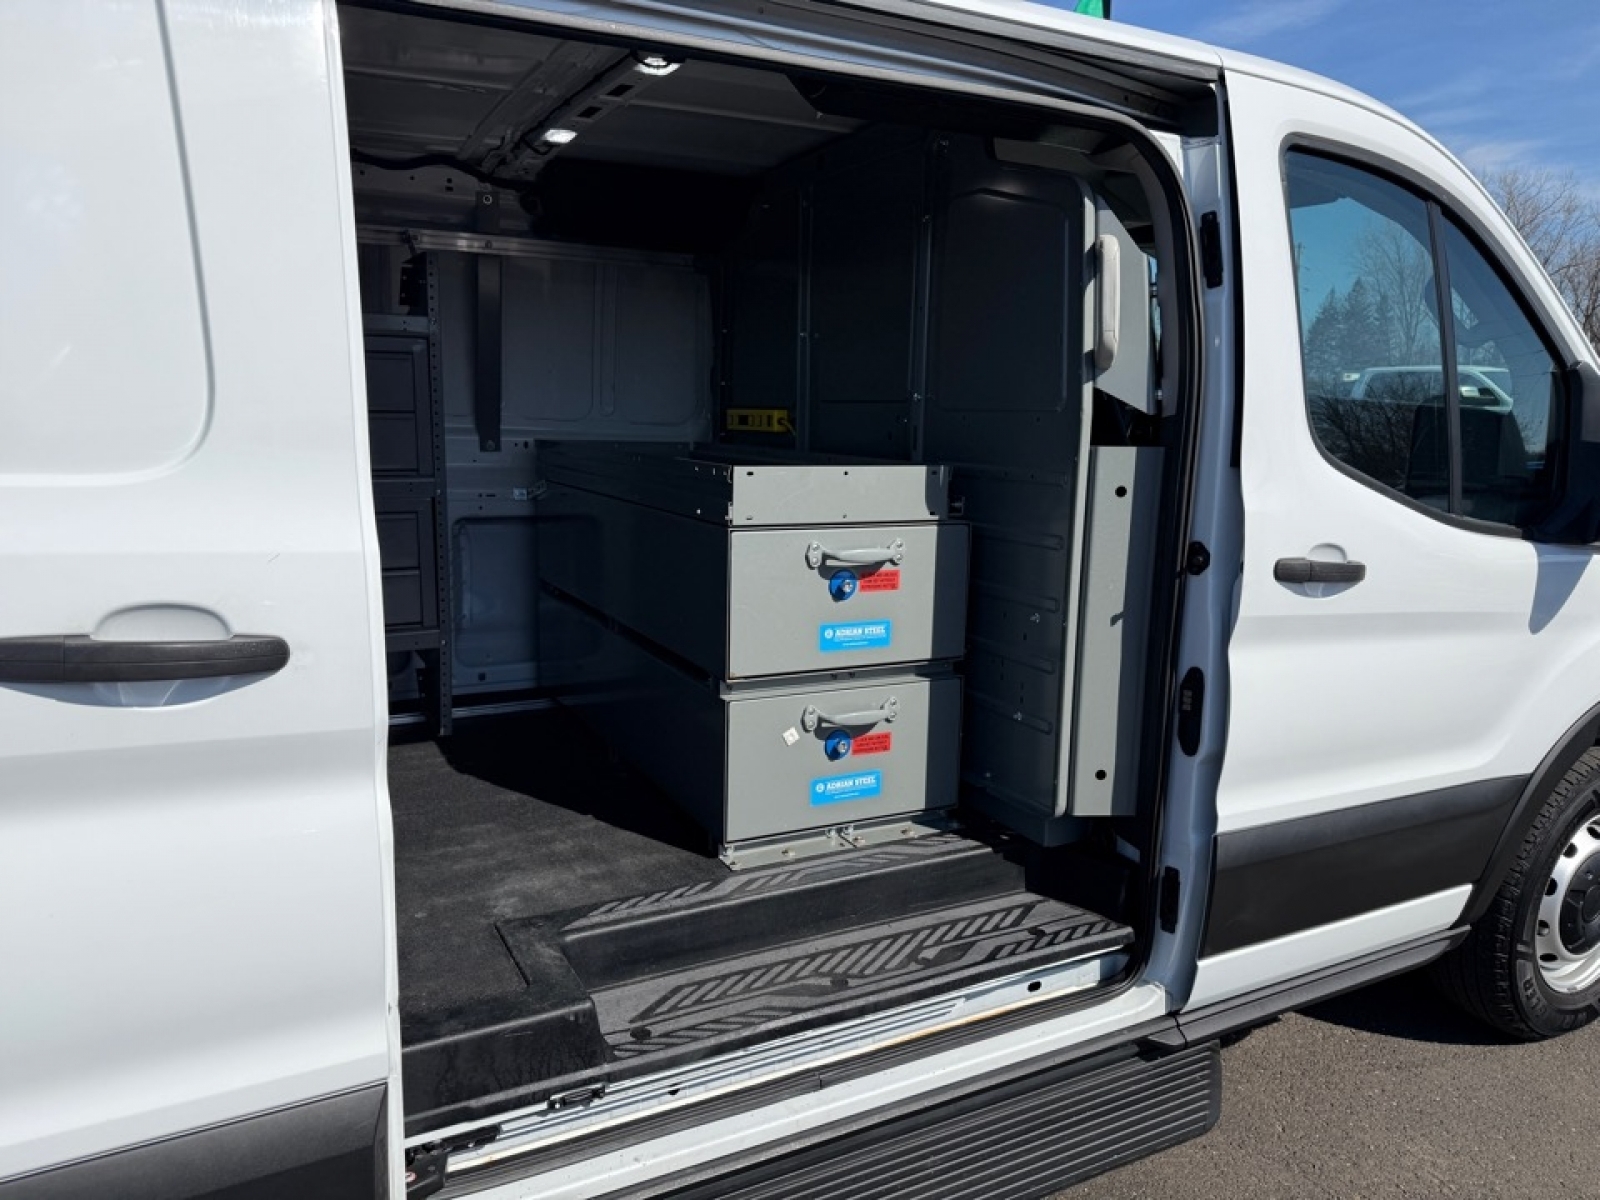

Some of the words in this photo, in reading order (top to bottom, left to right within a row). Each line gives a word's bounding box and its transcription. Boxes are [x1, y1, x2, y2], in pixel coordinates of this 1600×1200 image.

[836, 628, 862, 636] ADRIAN
[865, 626, 886, 635] STEEL
[826, 781, 853, 790] ADRIAN
[855, 776, 876, 785] STEEL
